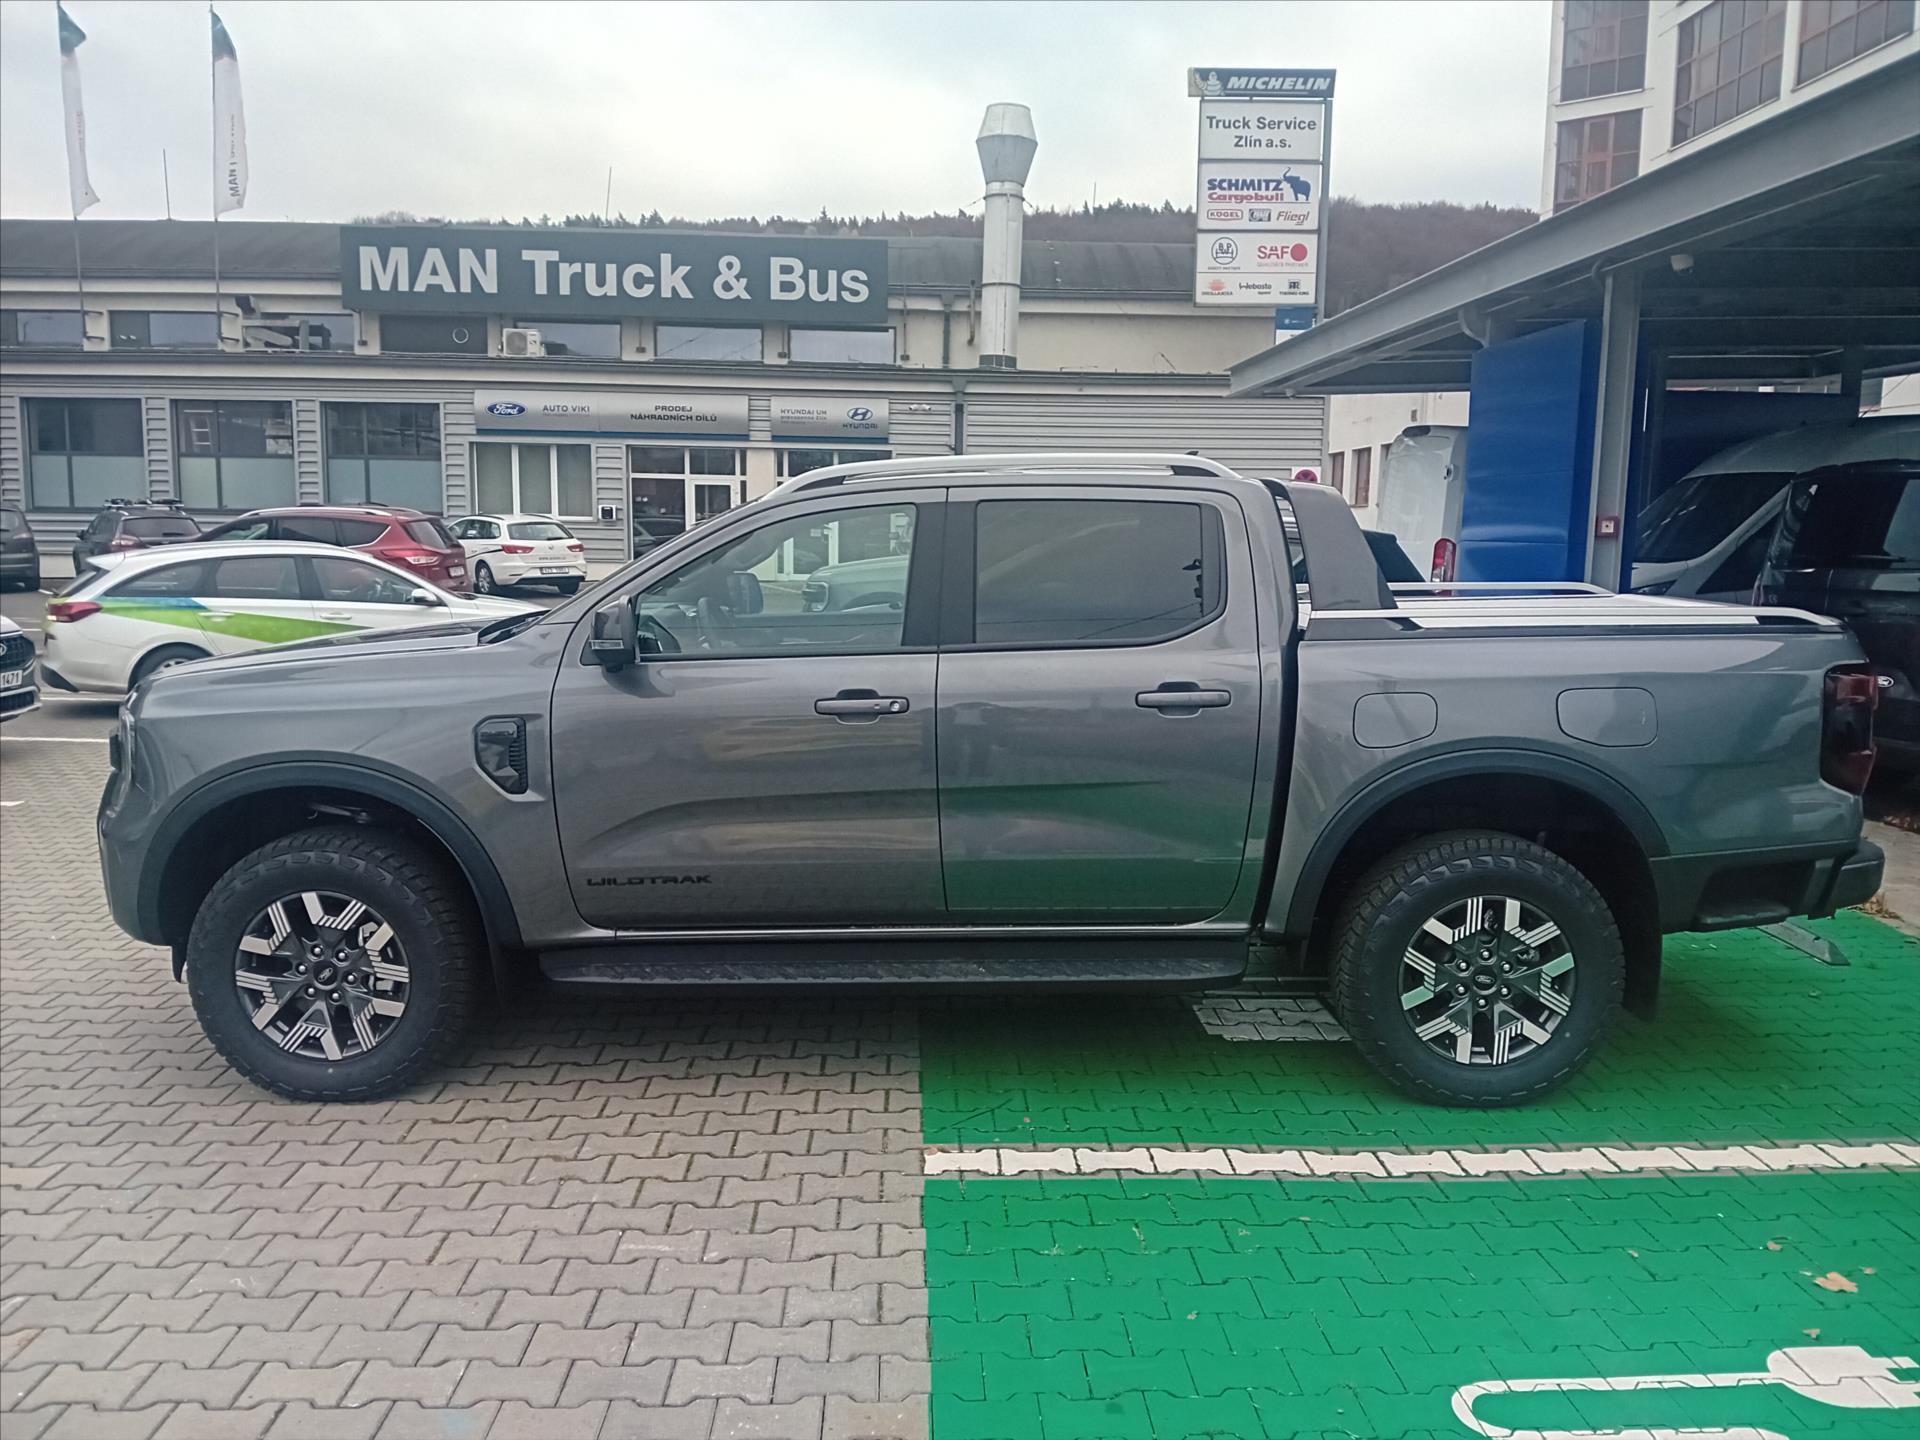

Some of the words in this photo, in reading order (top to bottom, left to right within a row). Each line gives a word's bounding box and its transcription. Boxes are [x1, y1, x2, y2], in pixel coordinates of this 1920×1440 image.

[1227, 76, 1330, 90] MICHELIN
[1206, 116, 1251, 130] Truck
[1256, 117, 1317, 130] Service
[1234, 135, 1262, 148] Zlín
[1265, 138, 1292, 148] a.s.
[228, 168, 240, 197] MAN
[1207, 178, 1284, 191] SCHMITZ
[1207, 192, 1284, 203] Cargobull
[1276, 211, 1310, 223] Fliegl
[358, 246, 498, 294] MAN
[521, 249, 694, 298] Truck
[713, 255, 752, 300] &
[770, 256, 870, 303] Bus
[494, 403, 519, 414] Ford
[542, 405, 568, 413] AUTO
[571, 405, 590, 413] VIKI
[630, 412, 693, 421] NÁHRADNÍCH
[696, 412, 717, 421] DÍLŮ
[587, 875, 712, 886] WILDTRAK
